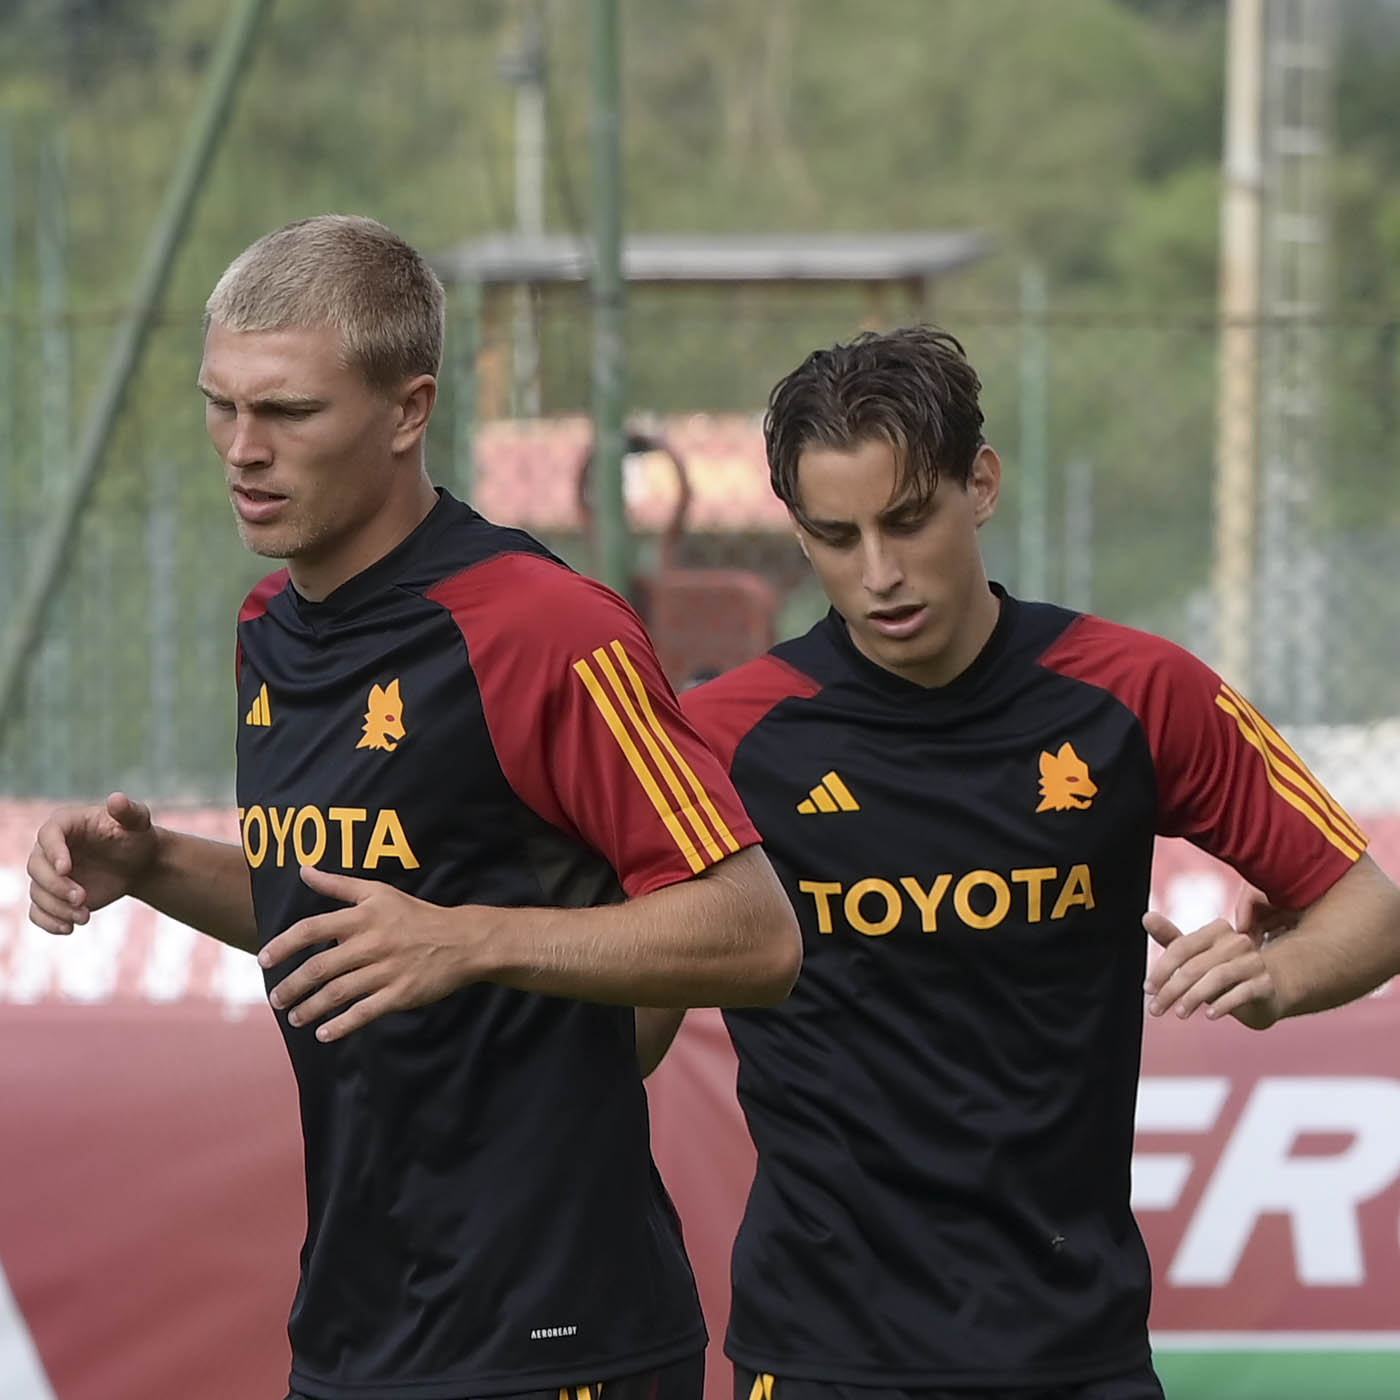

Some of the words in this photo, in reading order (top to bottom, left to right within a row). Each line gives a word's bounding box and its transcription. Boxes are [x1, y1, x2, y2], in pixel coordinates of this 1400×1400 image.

[238, 804, 421, 870] OYOTA
[799, 863, 1096, 937] TOYOTA
[530, 1326, 577, 1339] AEROREADY
